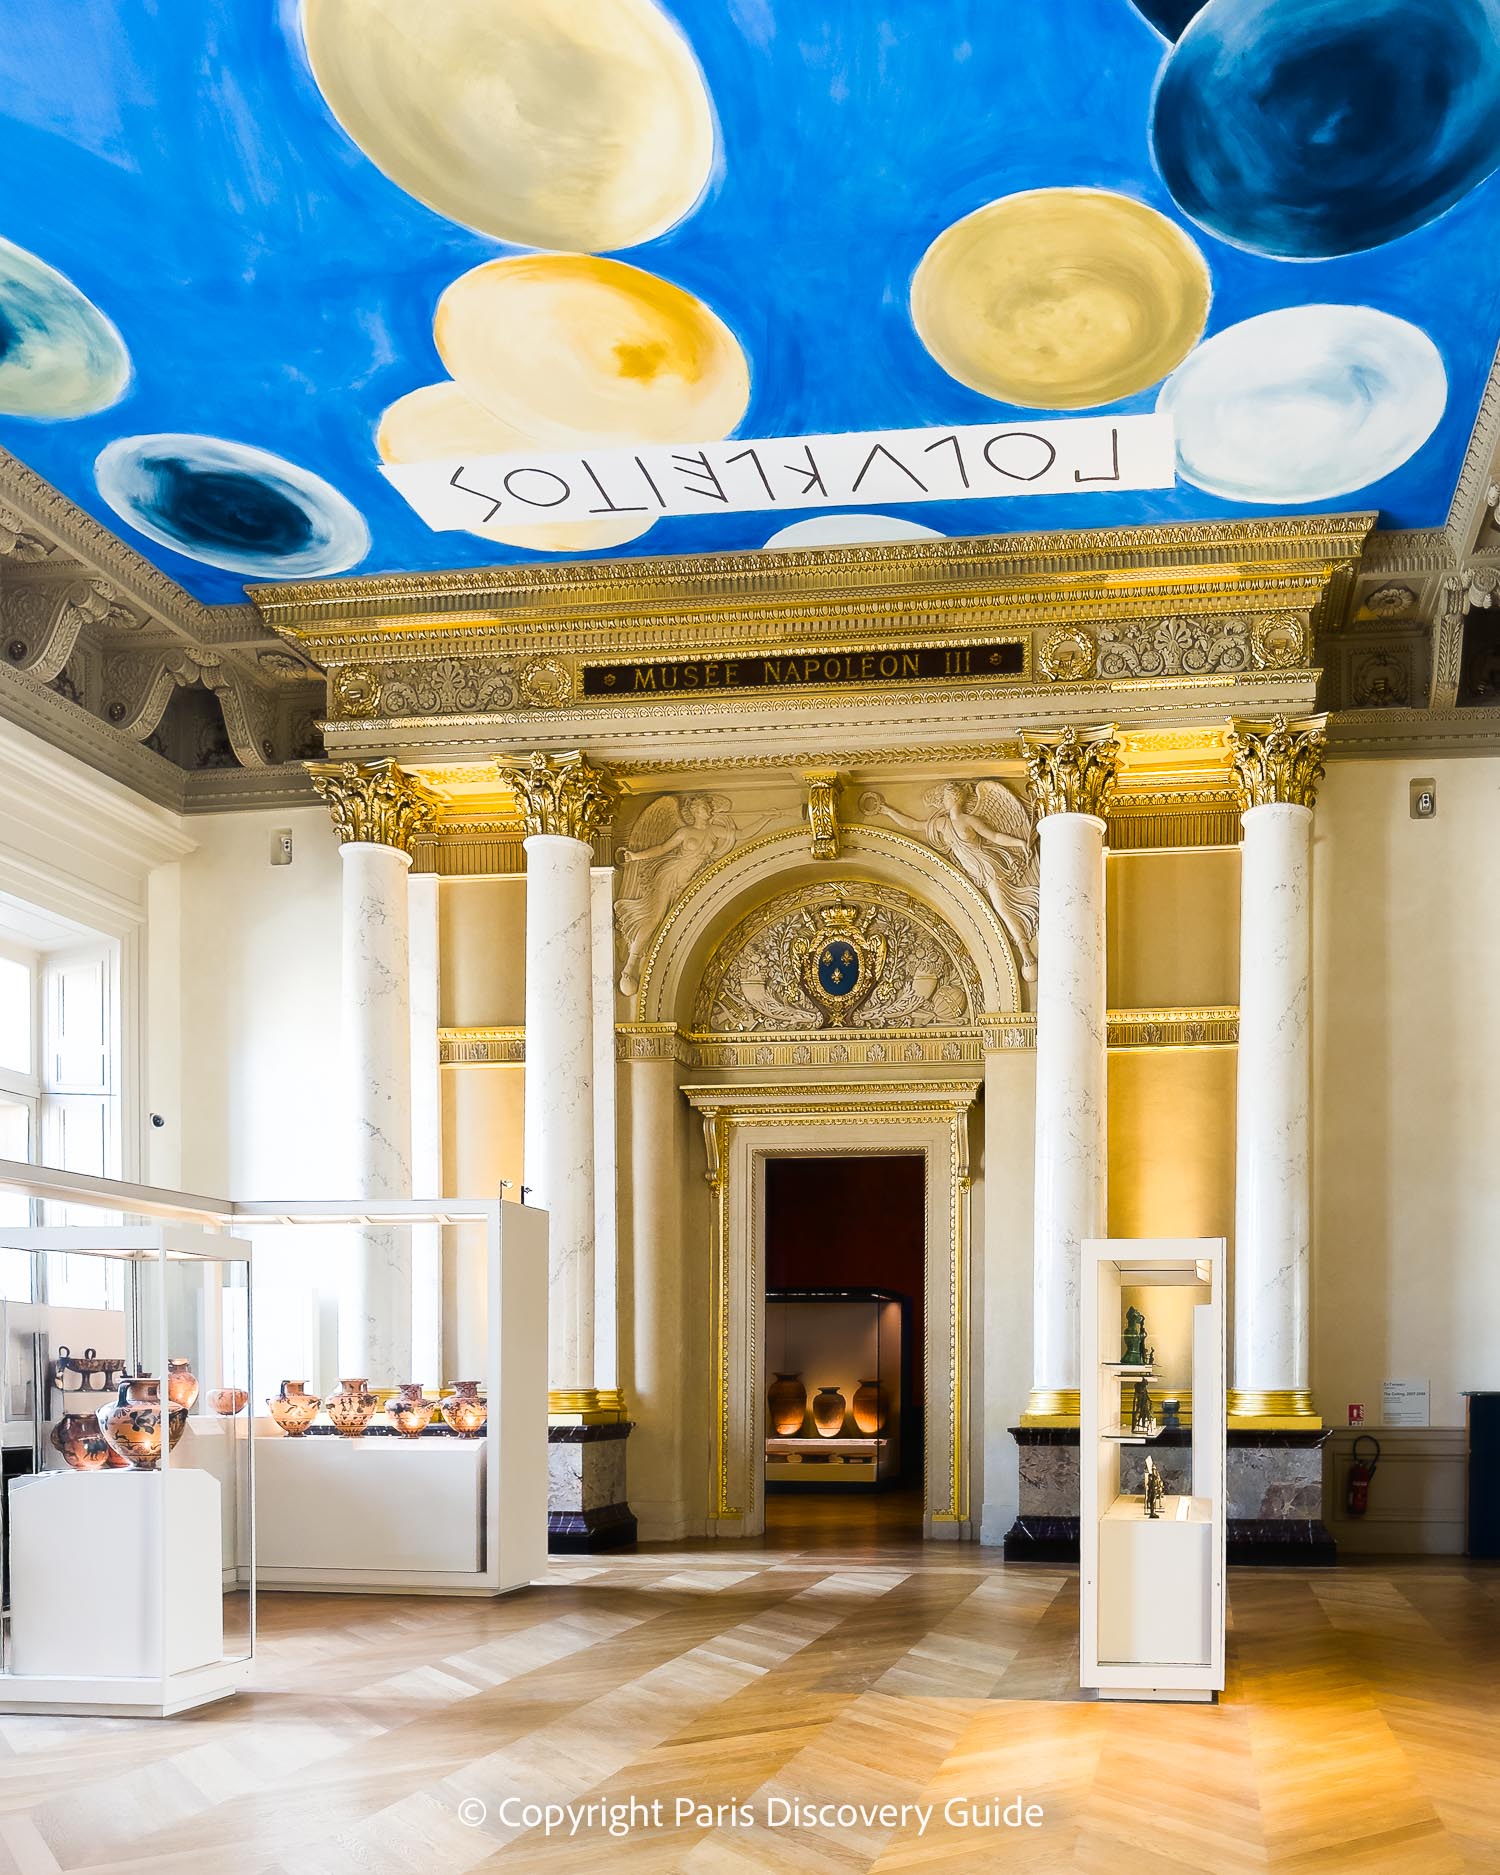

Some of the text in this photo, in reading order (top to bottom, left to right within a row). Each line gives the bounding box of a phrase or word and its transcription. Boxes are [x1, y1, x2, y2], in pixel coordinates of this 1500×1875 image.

[633, 651, 972, 690] MUSÉE NAPOLÉON III
